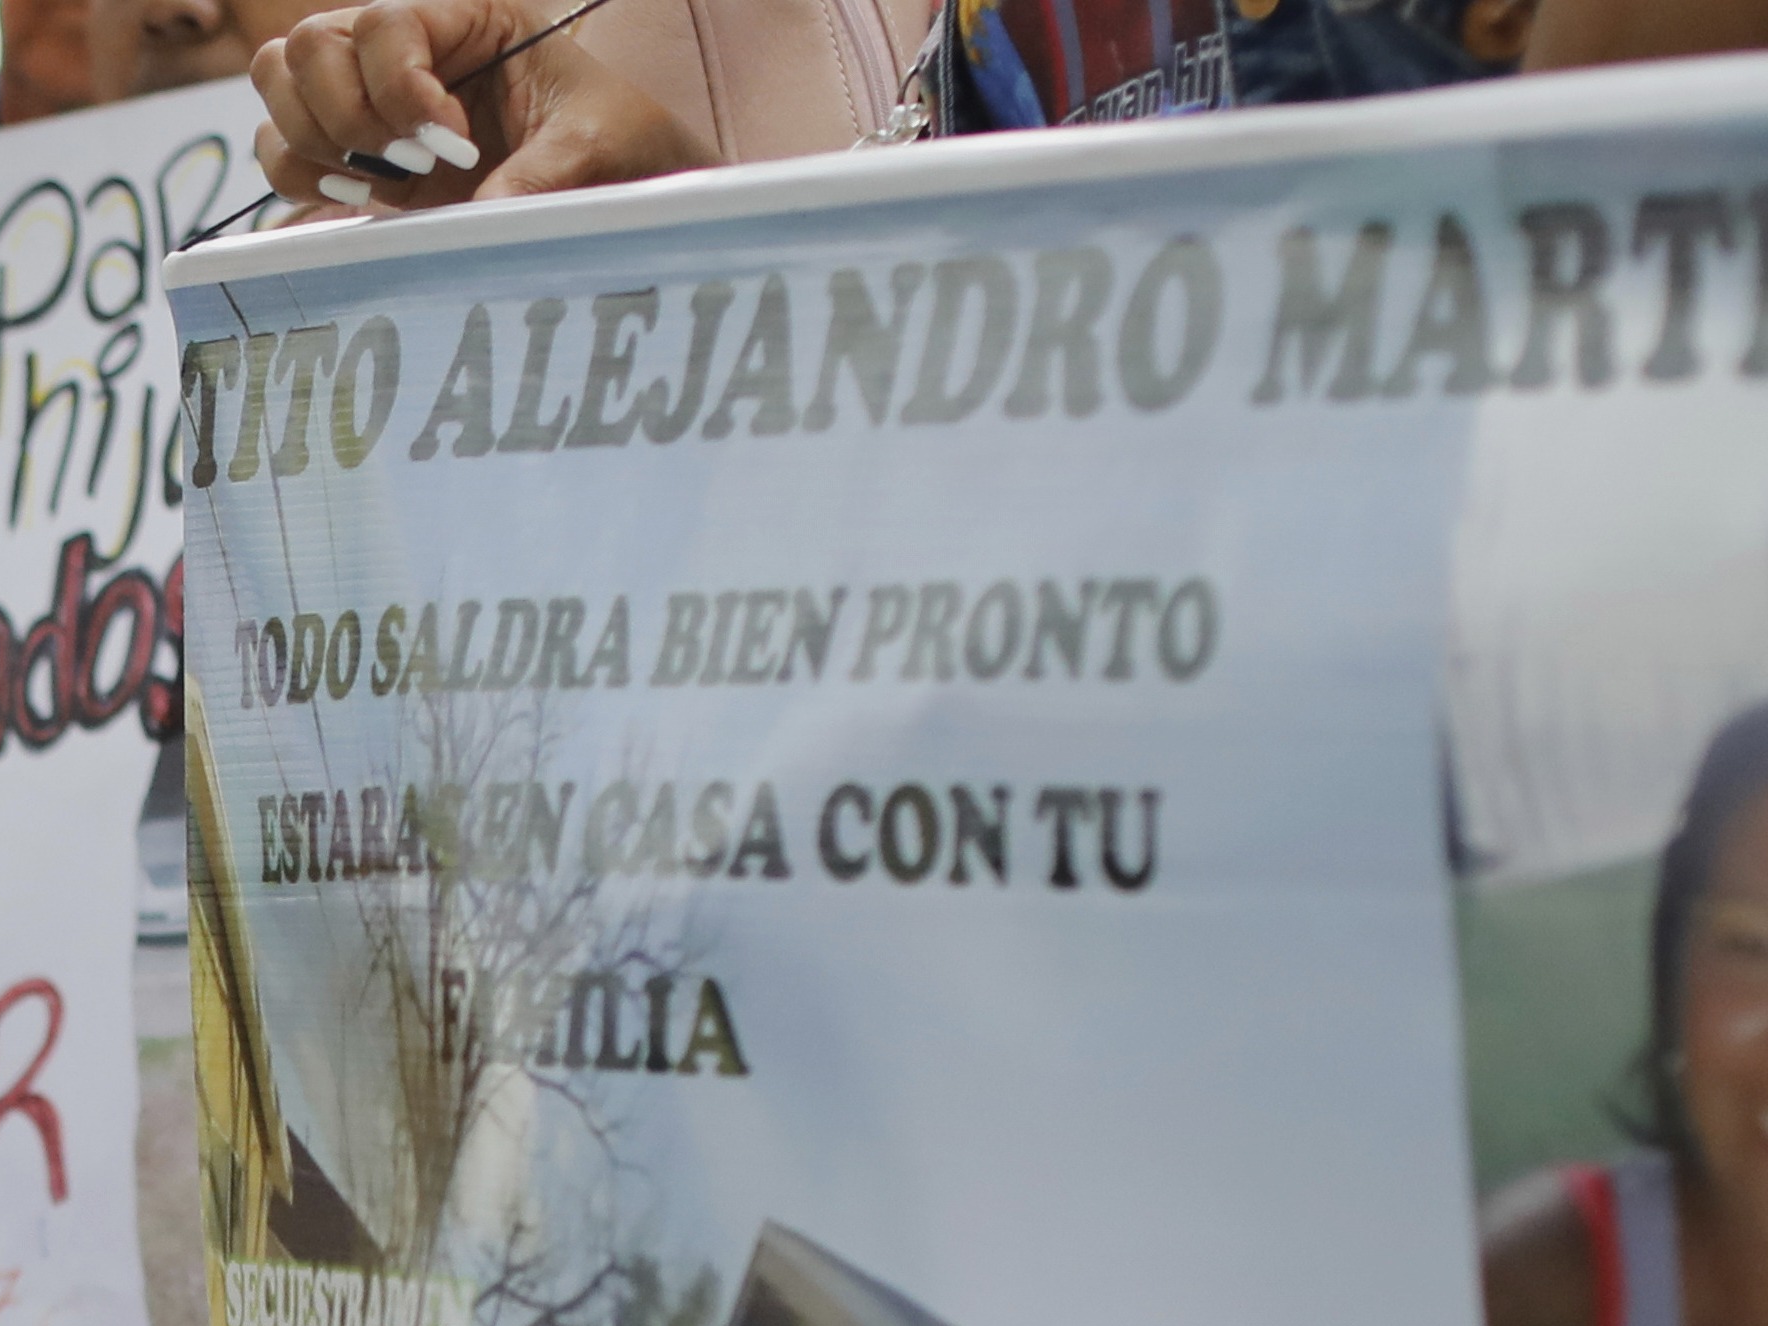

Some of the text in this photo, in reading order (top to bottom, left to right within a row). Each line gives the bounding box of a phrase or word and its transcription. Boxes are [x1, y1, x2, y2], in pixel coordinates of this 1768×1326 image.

[408, 232, 1225, 462] ALEJANDRO
[234, 576, 1220, 709] TODO SALDRA BIEN PRONTO
[583, 780, 794, 881] CASA
[817, 783, 1010, 885] CON
[1033, 788, 1165, 893] TU
